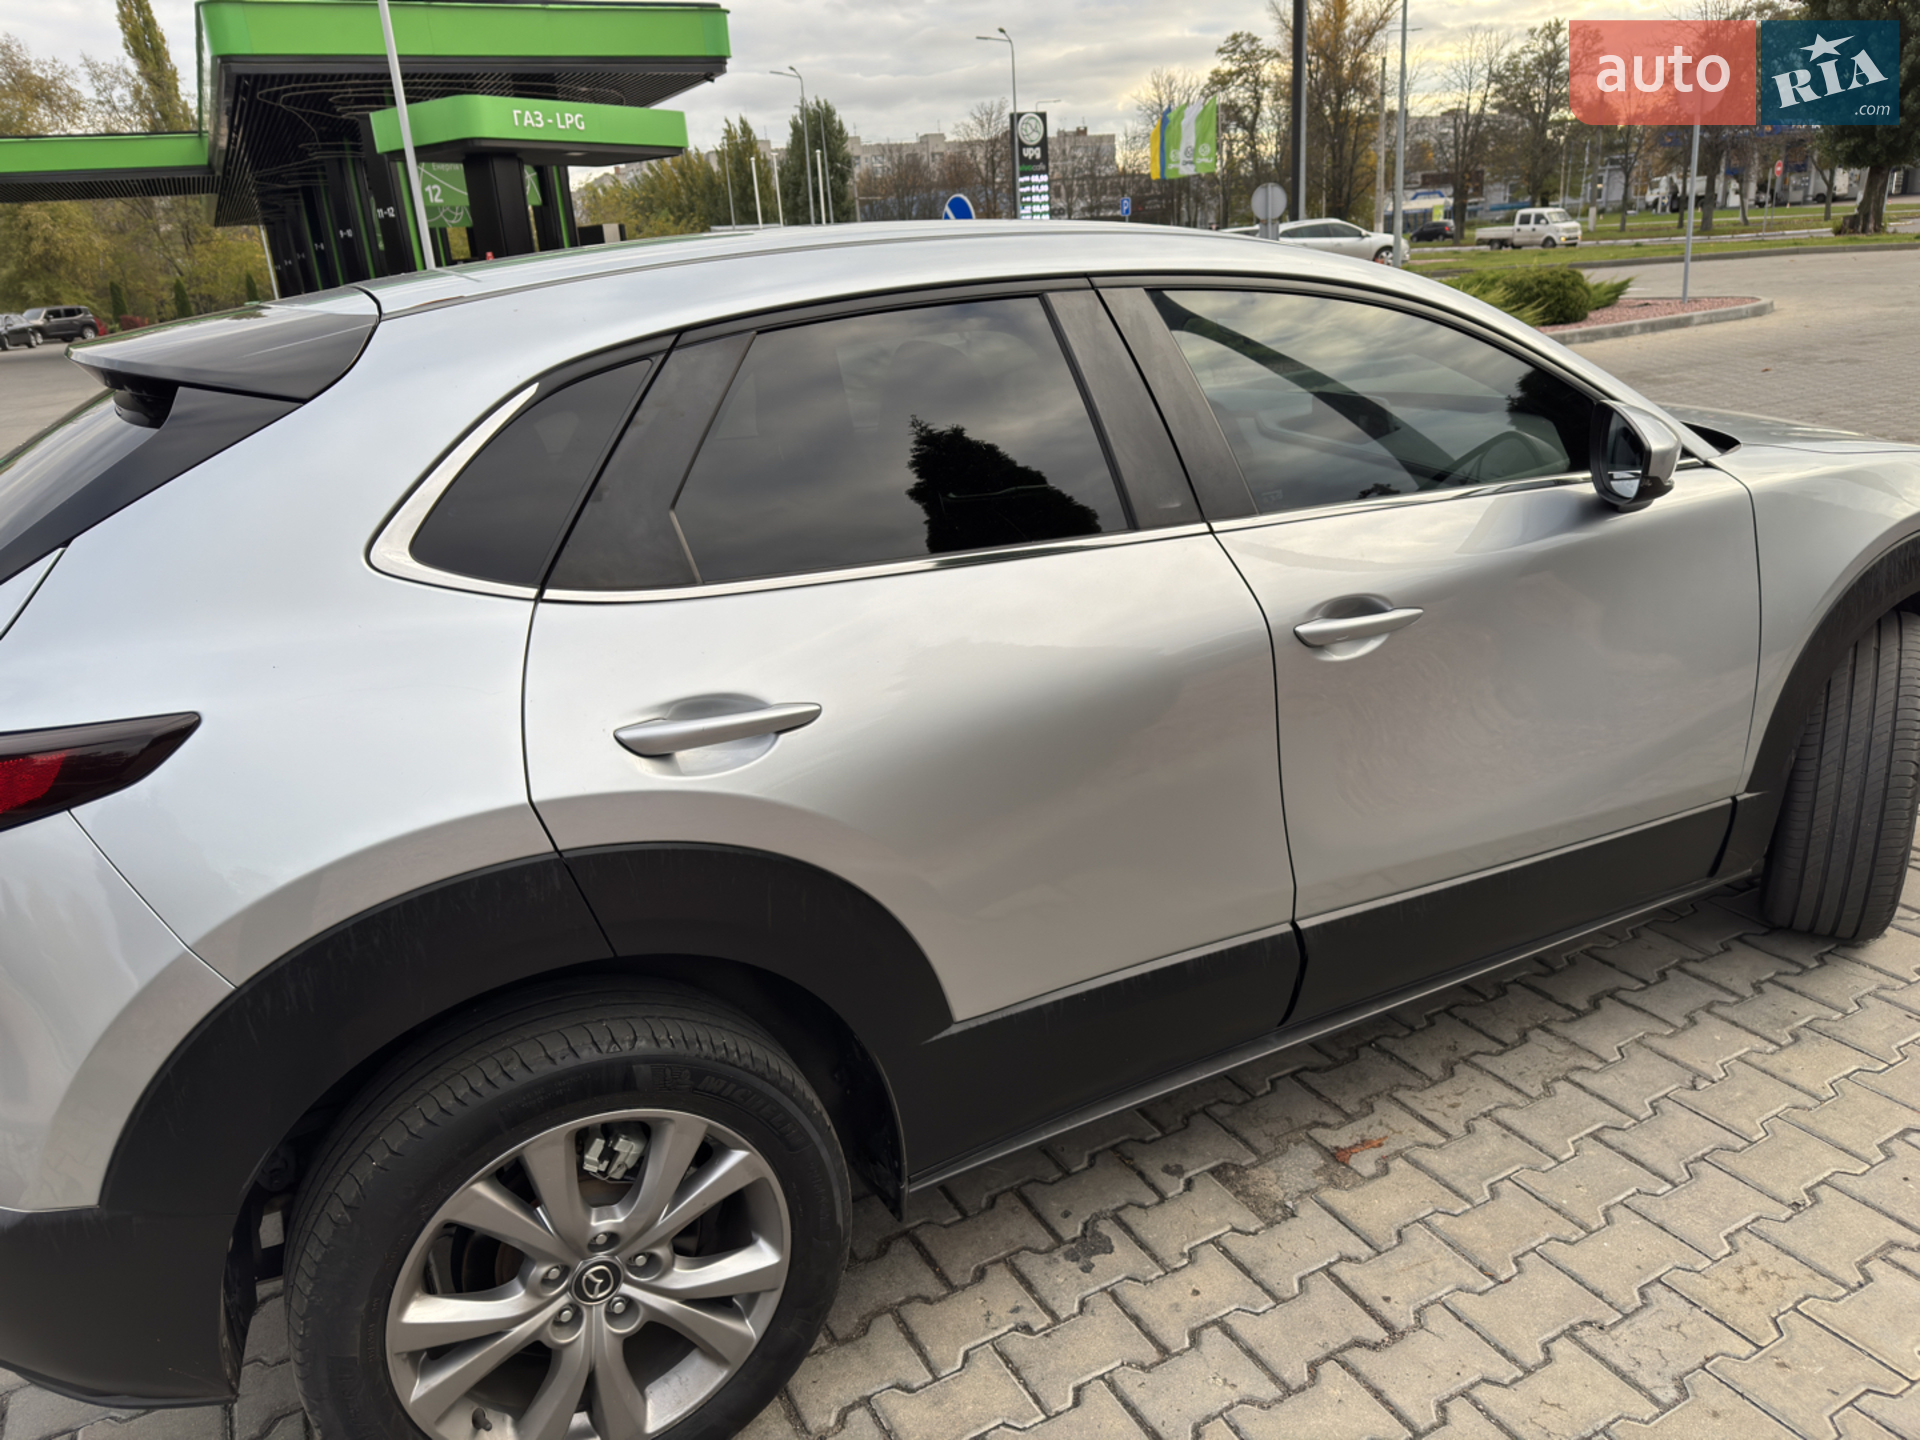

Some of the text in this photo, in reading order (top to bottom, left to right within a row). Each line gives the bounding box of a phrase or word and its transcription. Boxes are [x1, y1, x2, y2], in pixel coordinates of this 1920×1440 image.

[512, 109, 544, 128] ГАЗ
[556, 112, 585, 130] LPG
[1022, 146, 1041, 160] upg
[424, 184, 444, 203] 12
[376, 206, 396, 219] 11-12
